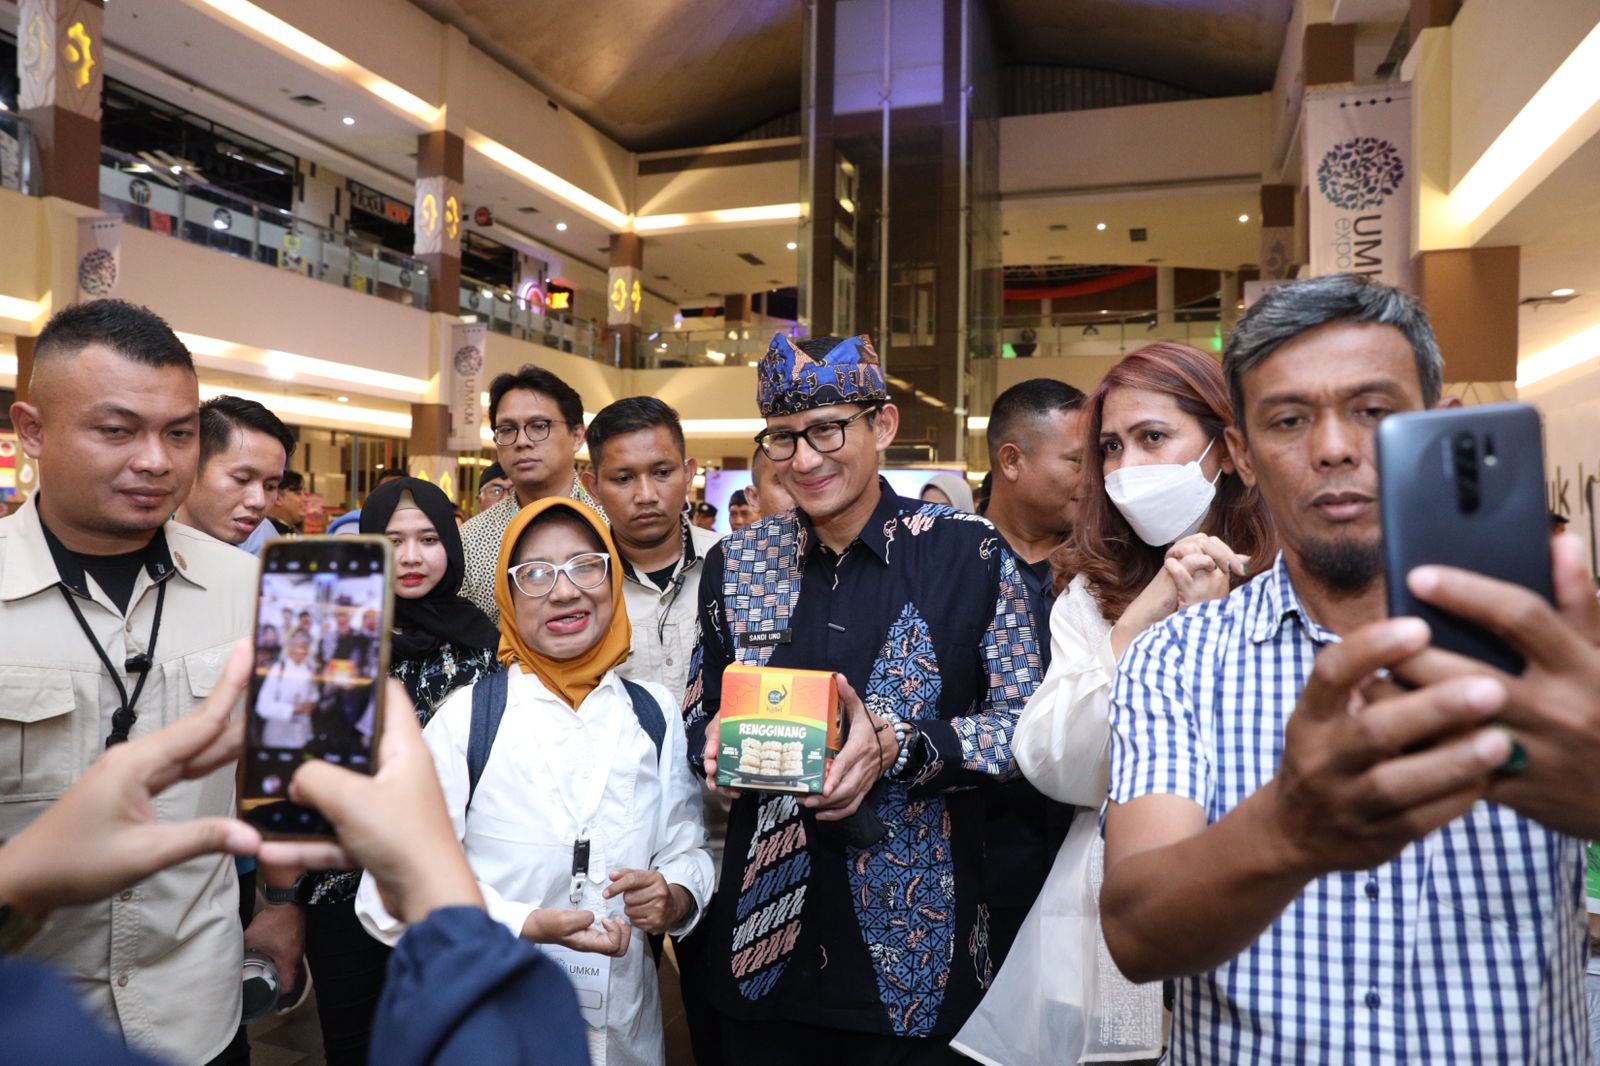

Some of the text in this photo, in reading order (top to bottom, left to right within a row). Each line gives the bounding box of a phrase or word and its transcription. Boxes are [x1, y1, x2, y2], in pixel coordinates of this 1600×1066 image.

[1330, 217, 1352, 270] expo
[464, 379, 475, 426] UMKM
[749, 632, 781, 642] SANDI UNO
[738, 722, 807, 739] RENGGINANG
[569, 964, 600, 977] UMKM
